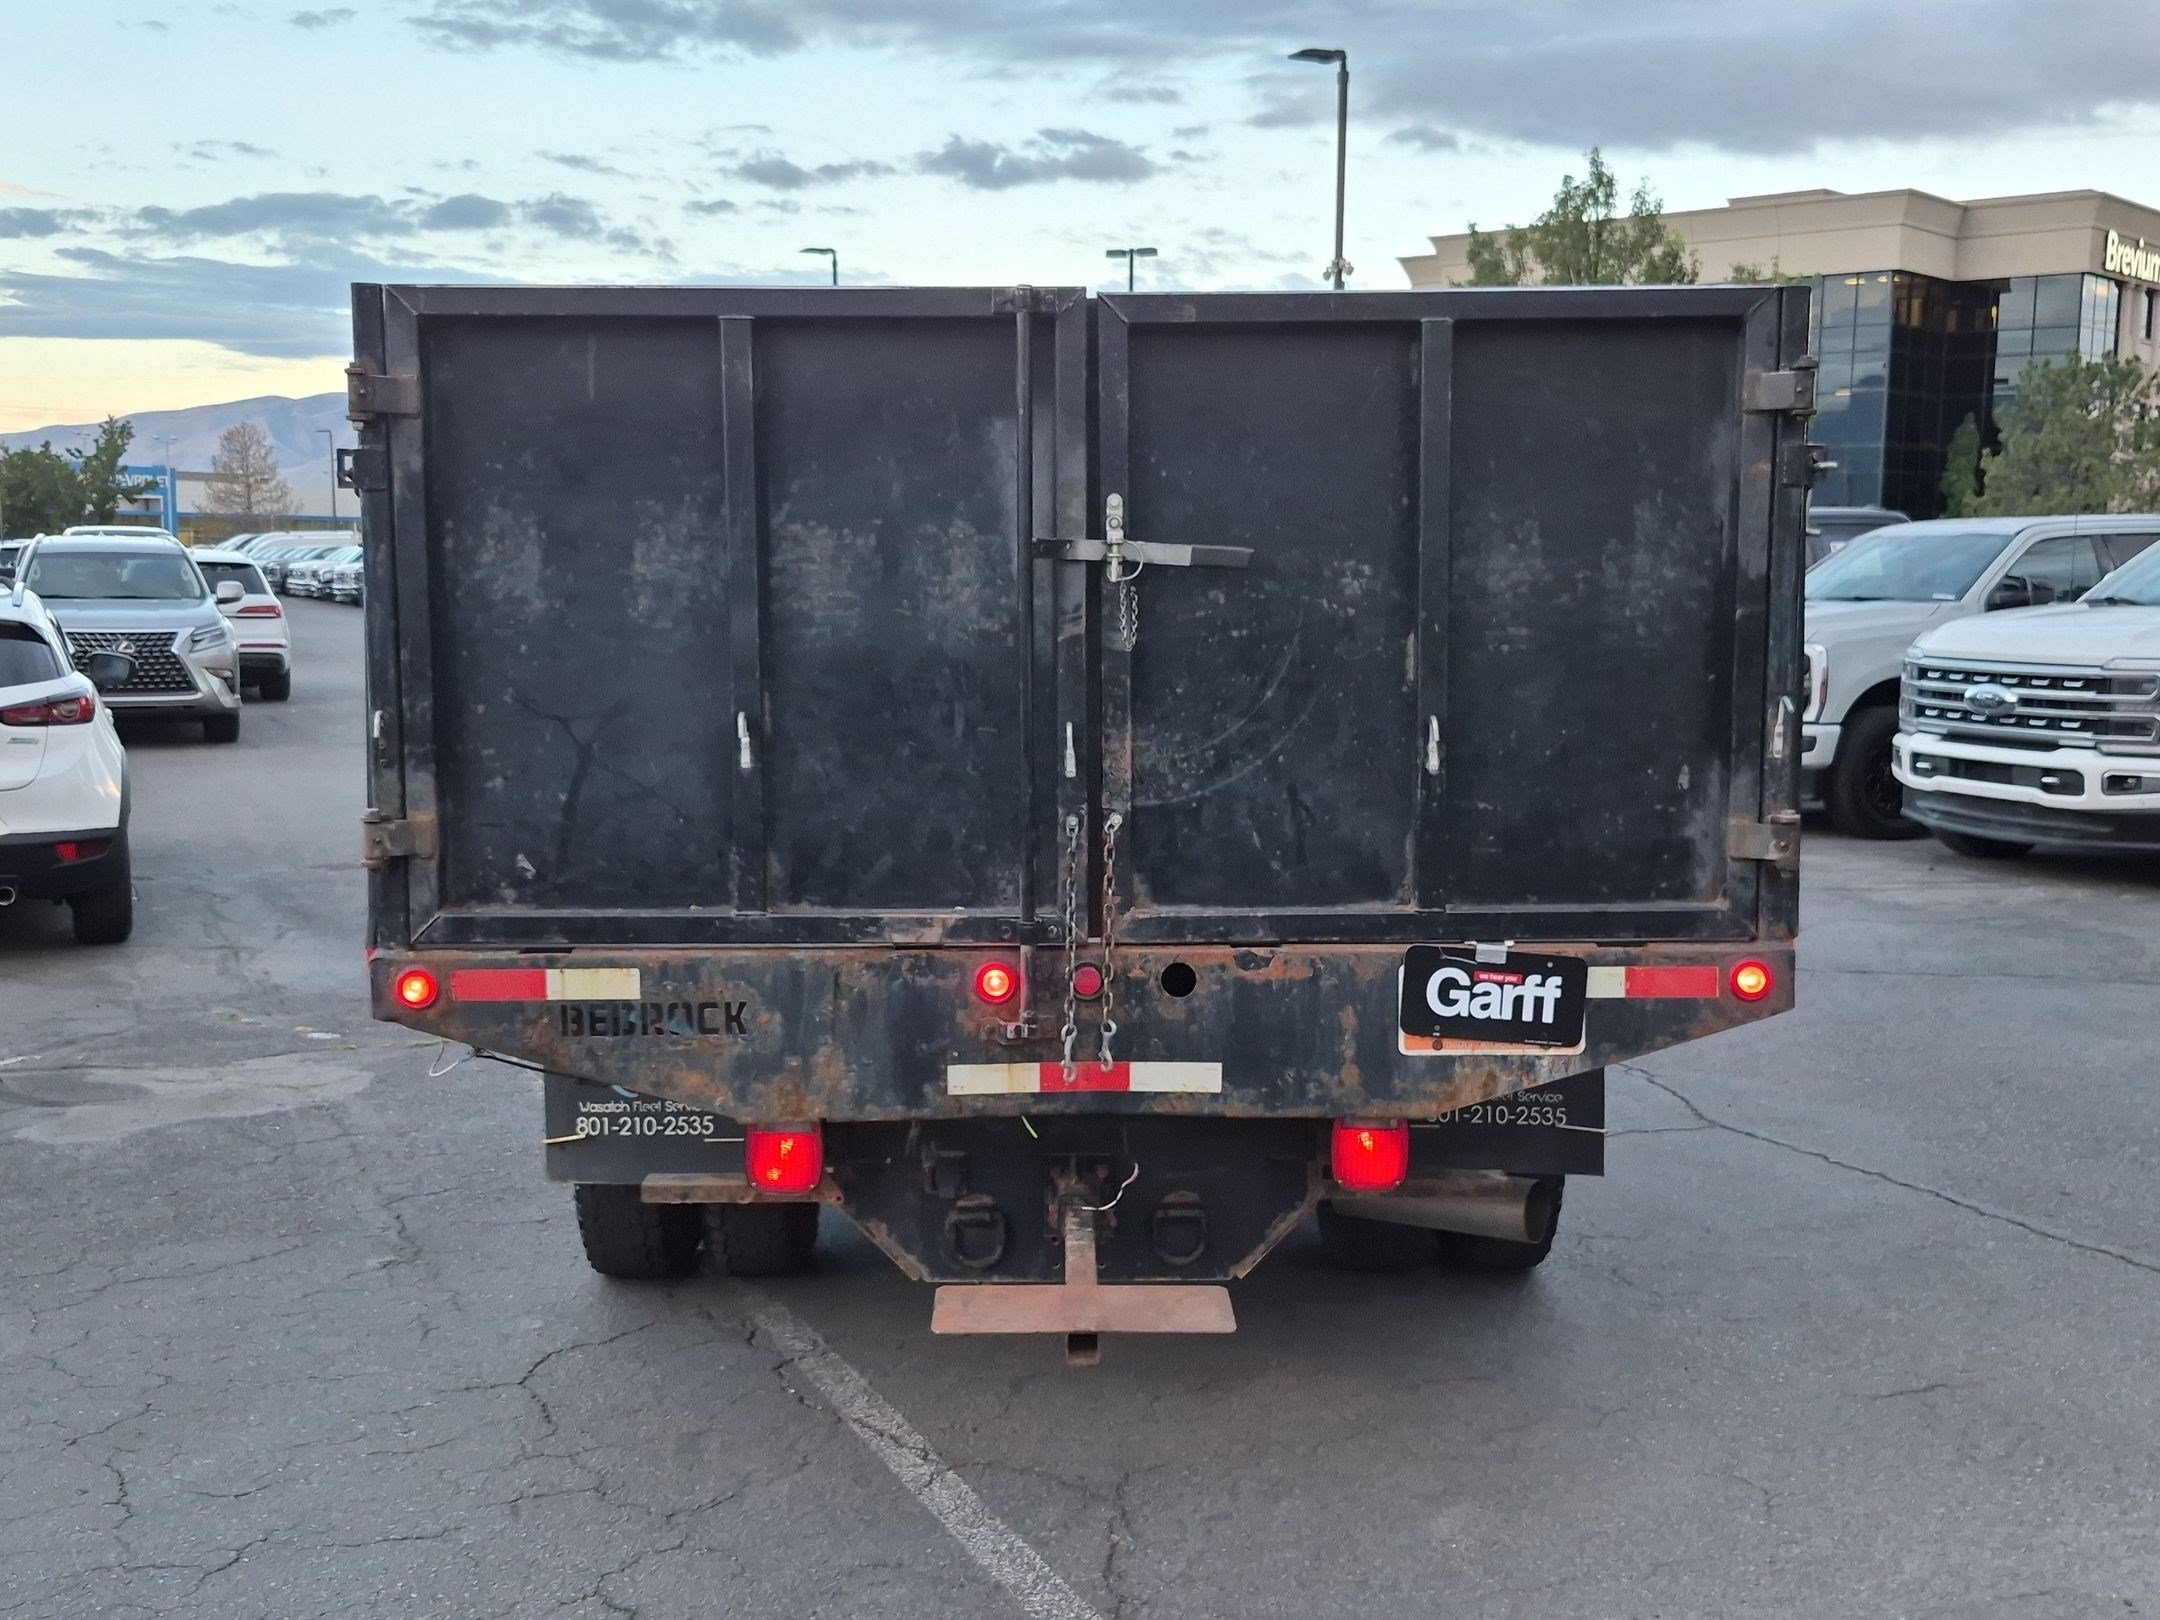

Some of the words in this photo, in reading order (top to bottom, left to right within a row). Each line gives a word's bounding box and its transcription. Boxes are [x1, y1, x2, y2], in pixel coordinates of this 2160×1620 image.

[1426, 967, 1562, 1024] Garff
[560, 1001, 748, 1037] BEDROCK
[1518, 1089, 1563, 1103] Service
[579, 1101, 631, 1113] Wasatch
[633, 1101, 661, 1113] Fleet
[576, 1116, 714, 1136] 801-210-2535
